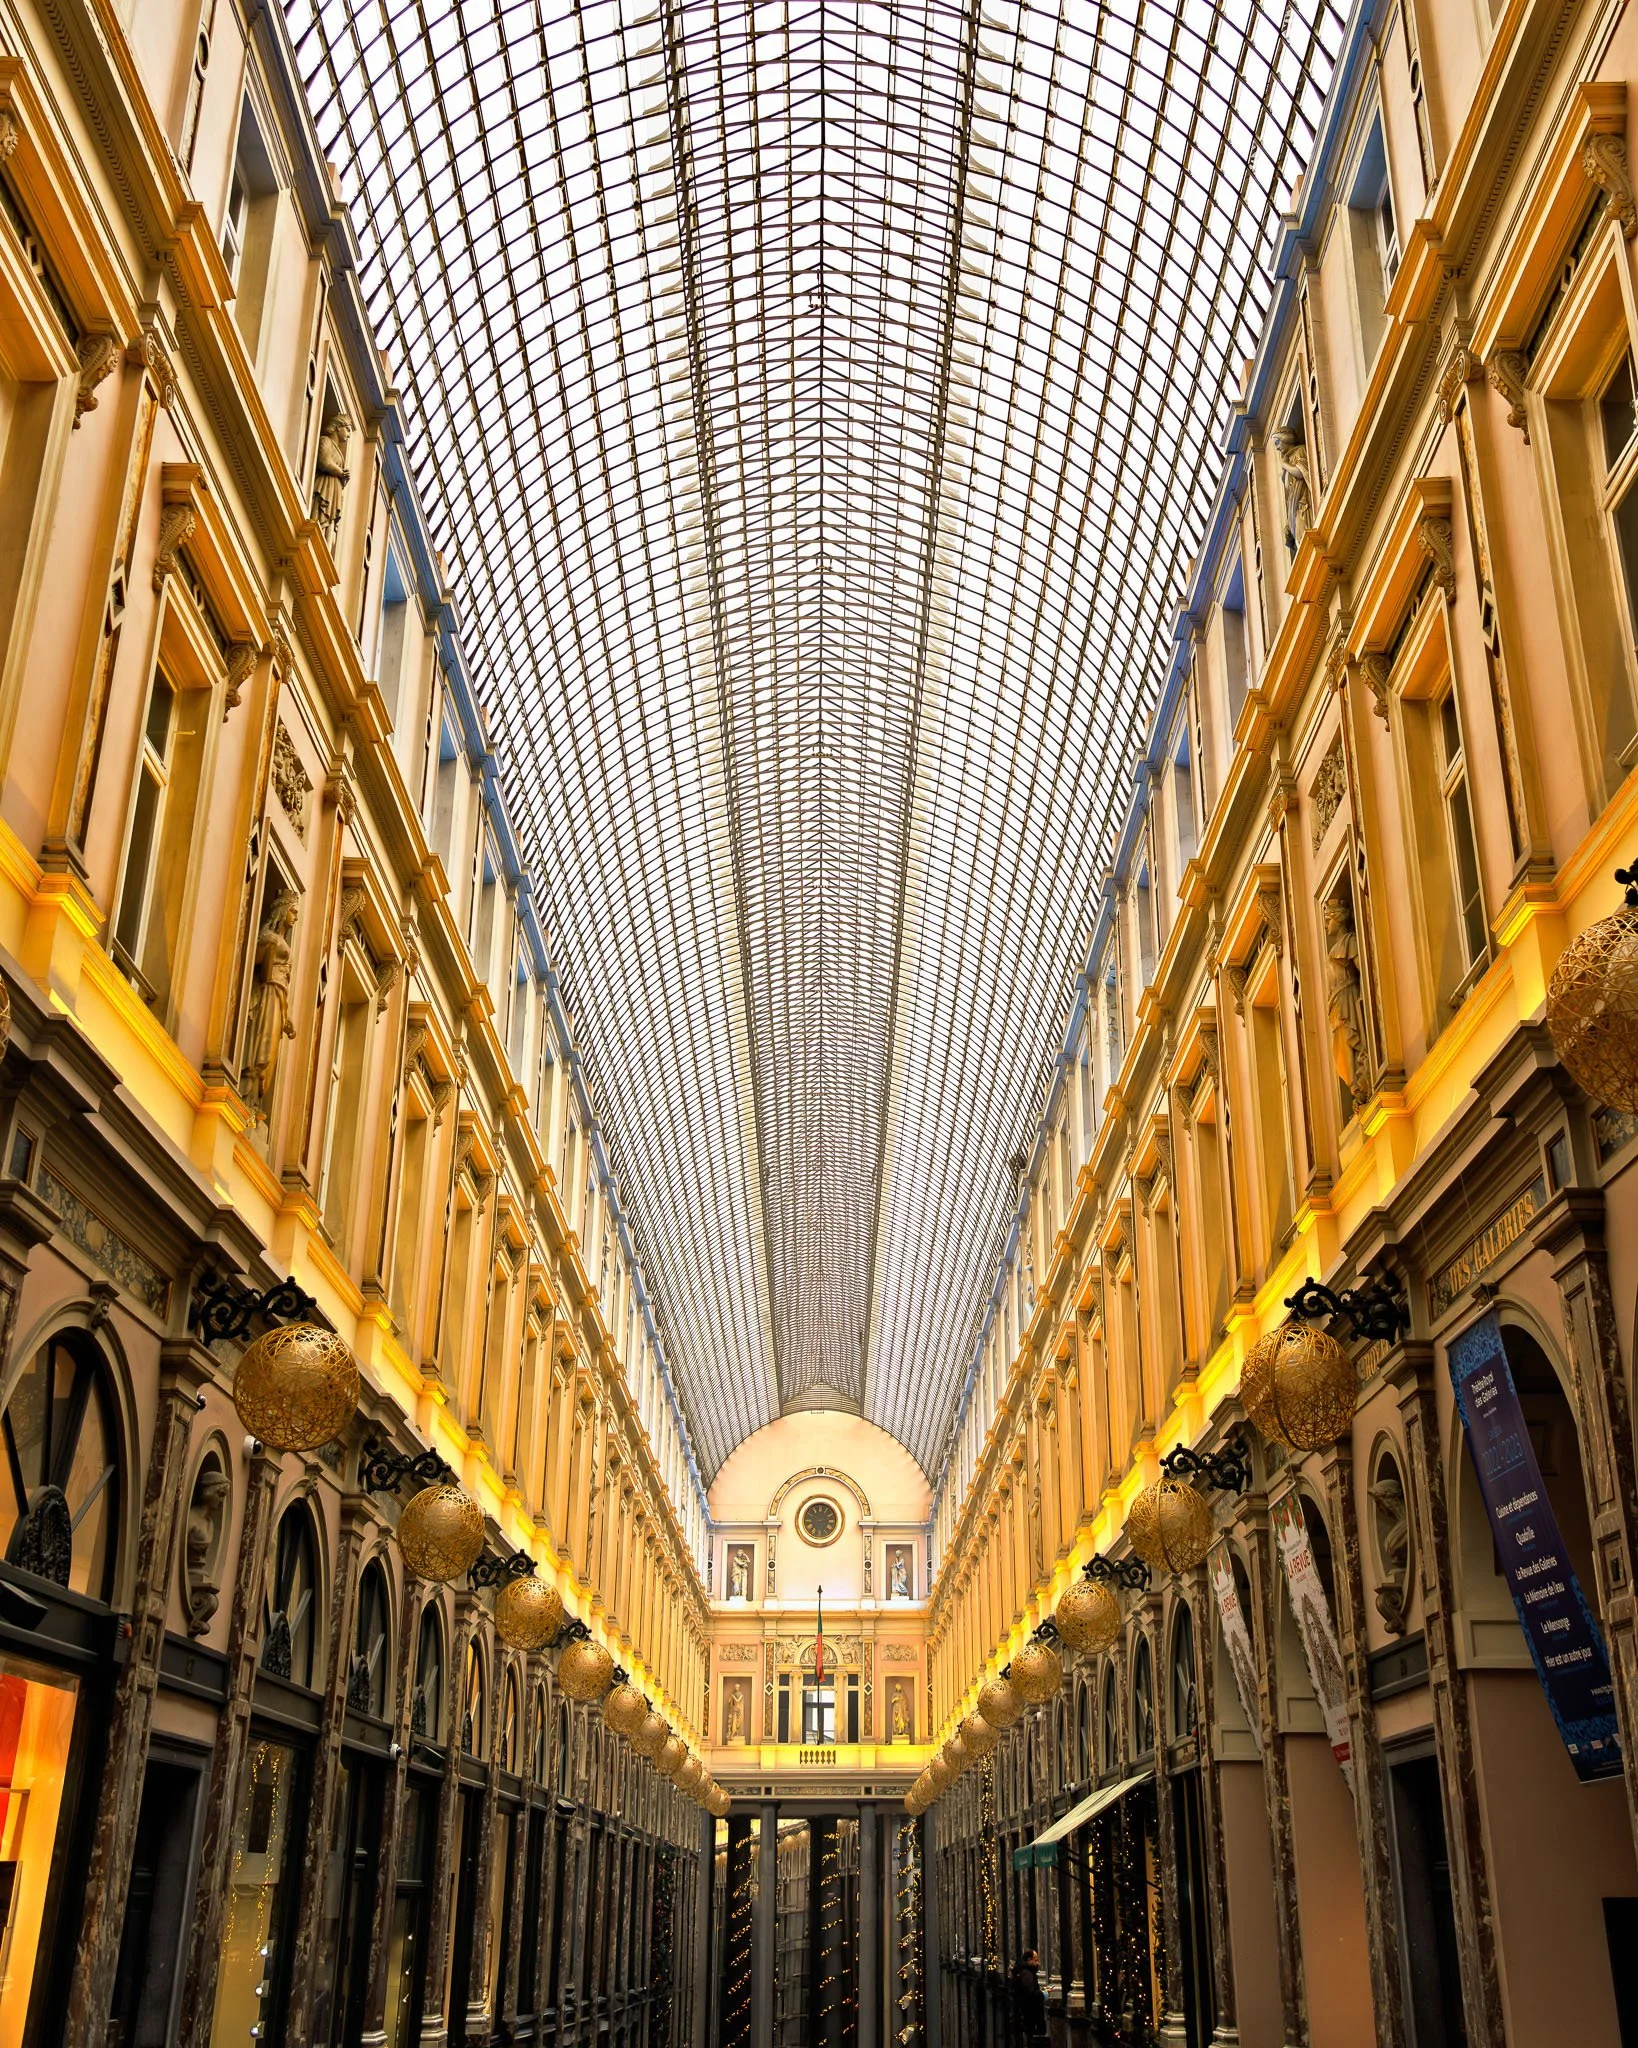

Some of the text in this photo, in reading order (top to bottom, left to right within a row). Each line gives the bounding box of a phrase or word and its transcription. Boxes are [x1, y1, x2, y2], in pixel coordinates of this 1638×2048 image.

[1449, 1189, 1534, 1297] DES GALERIES
[1475, 1386, 1498, 1408] des Galeries
[1495, 1504, 1509, 1518] Cuisine
[1292, 1549, 1310, 1574] REVUE
[1515, 1555, 1557, 1580] La Revue des Galeries
[1524, 1592, 1531, 1604] La
[1529, 1588, 1548, 1601] Mémoire
[1547, 1582, 1555, 1596] de
[1540, 1617, 1570, 1634] Le Mensonge
[1544, 1656, 1556, 1668] Hier
[1555, 1653, 1563, 1665] est
[1568, 1649, 1582, 1661] autre
[1579, 1646, 1592, 1662] jour
